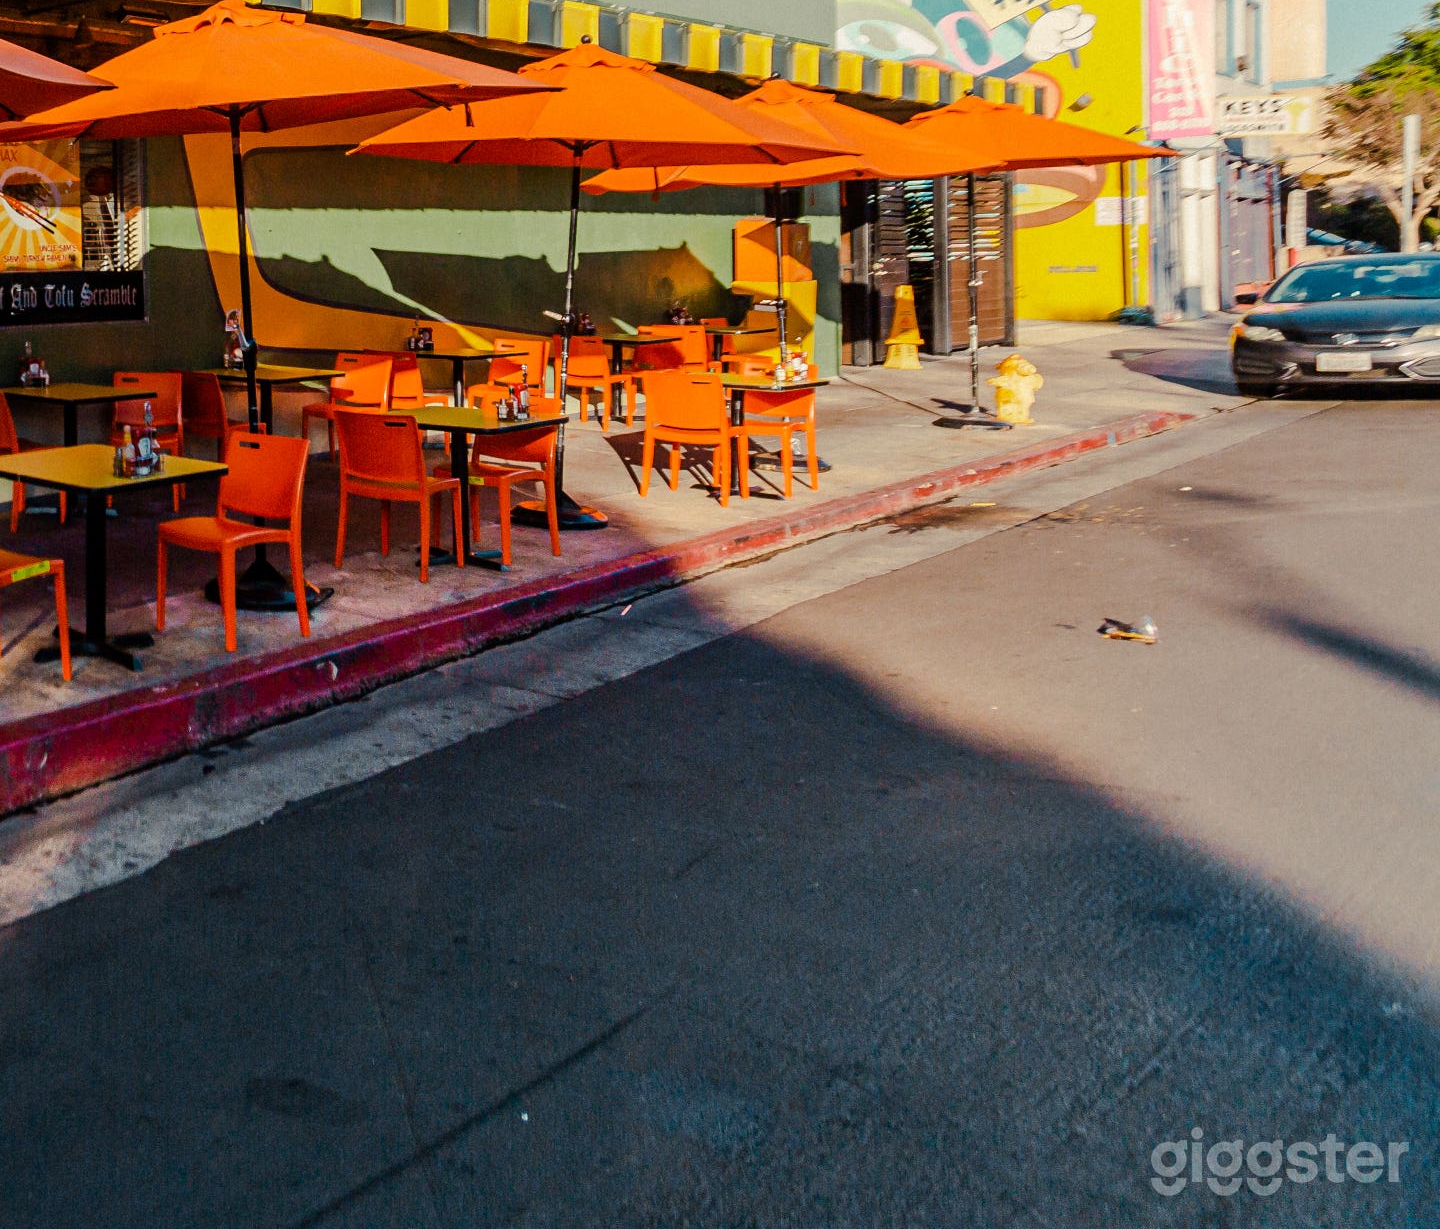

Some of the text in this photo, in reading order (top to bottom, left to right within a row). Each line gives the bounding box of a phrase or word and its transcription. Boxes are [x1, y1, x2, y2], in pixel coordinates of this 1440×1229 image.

[11, 283, 37, 310] And
[44, 284, 74, 309] Tofu
[80, 282, 137, 307] Scramble
